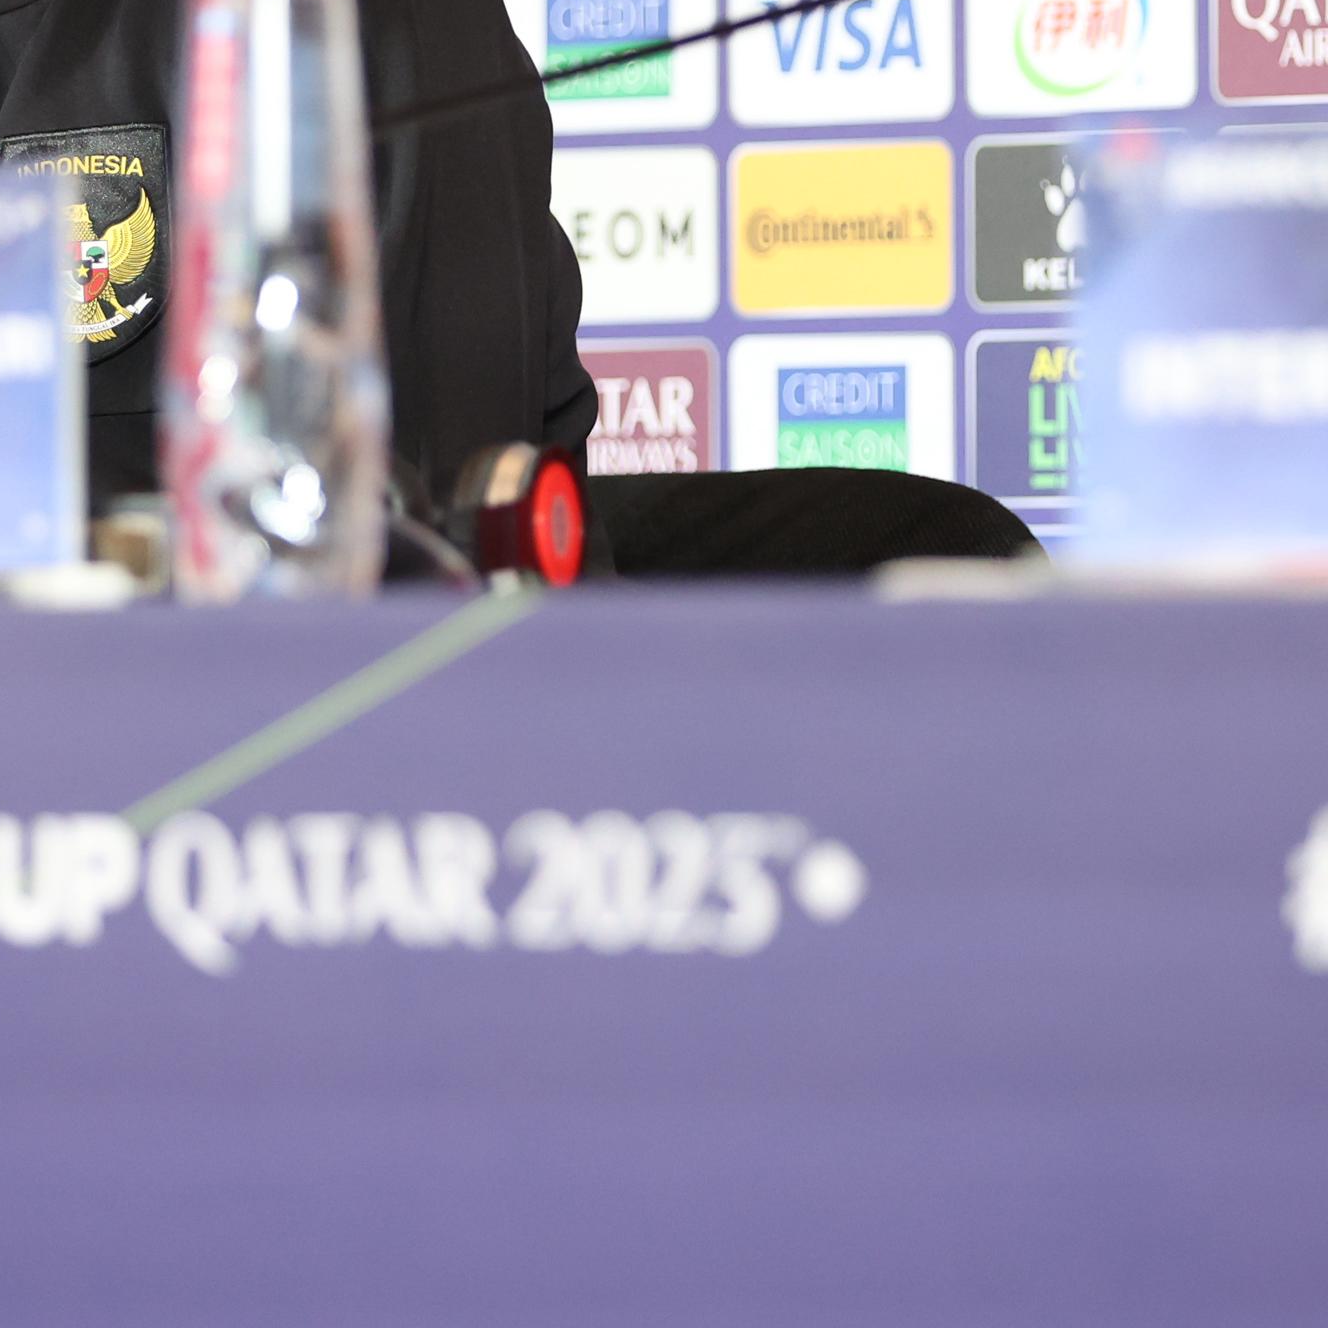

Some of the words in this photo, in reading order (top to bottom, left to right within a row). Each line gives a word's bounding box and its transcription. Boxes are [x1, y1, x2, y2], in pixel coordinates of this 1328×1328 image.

[575, 210, 695, 260] EOM
[746, 208, 910, 254] Continental
[1023, 257, 1083, 292] KEL
[586, 376, 697, 439] TAR
[782, 371, 901, 416] CREDIT
[144, 808, 500, 979] QATAR
